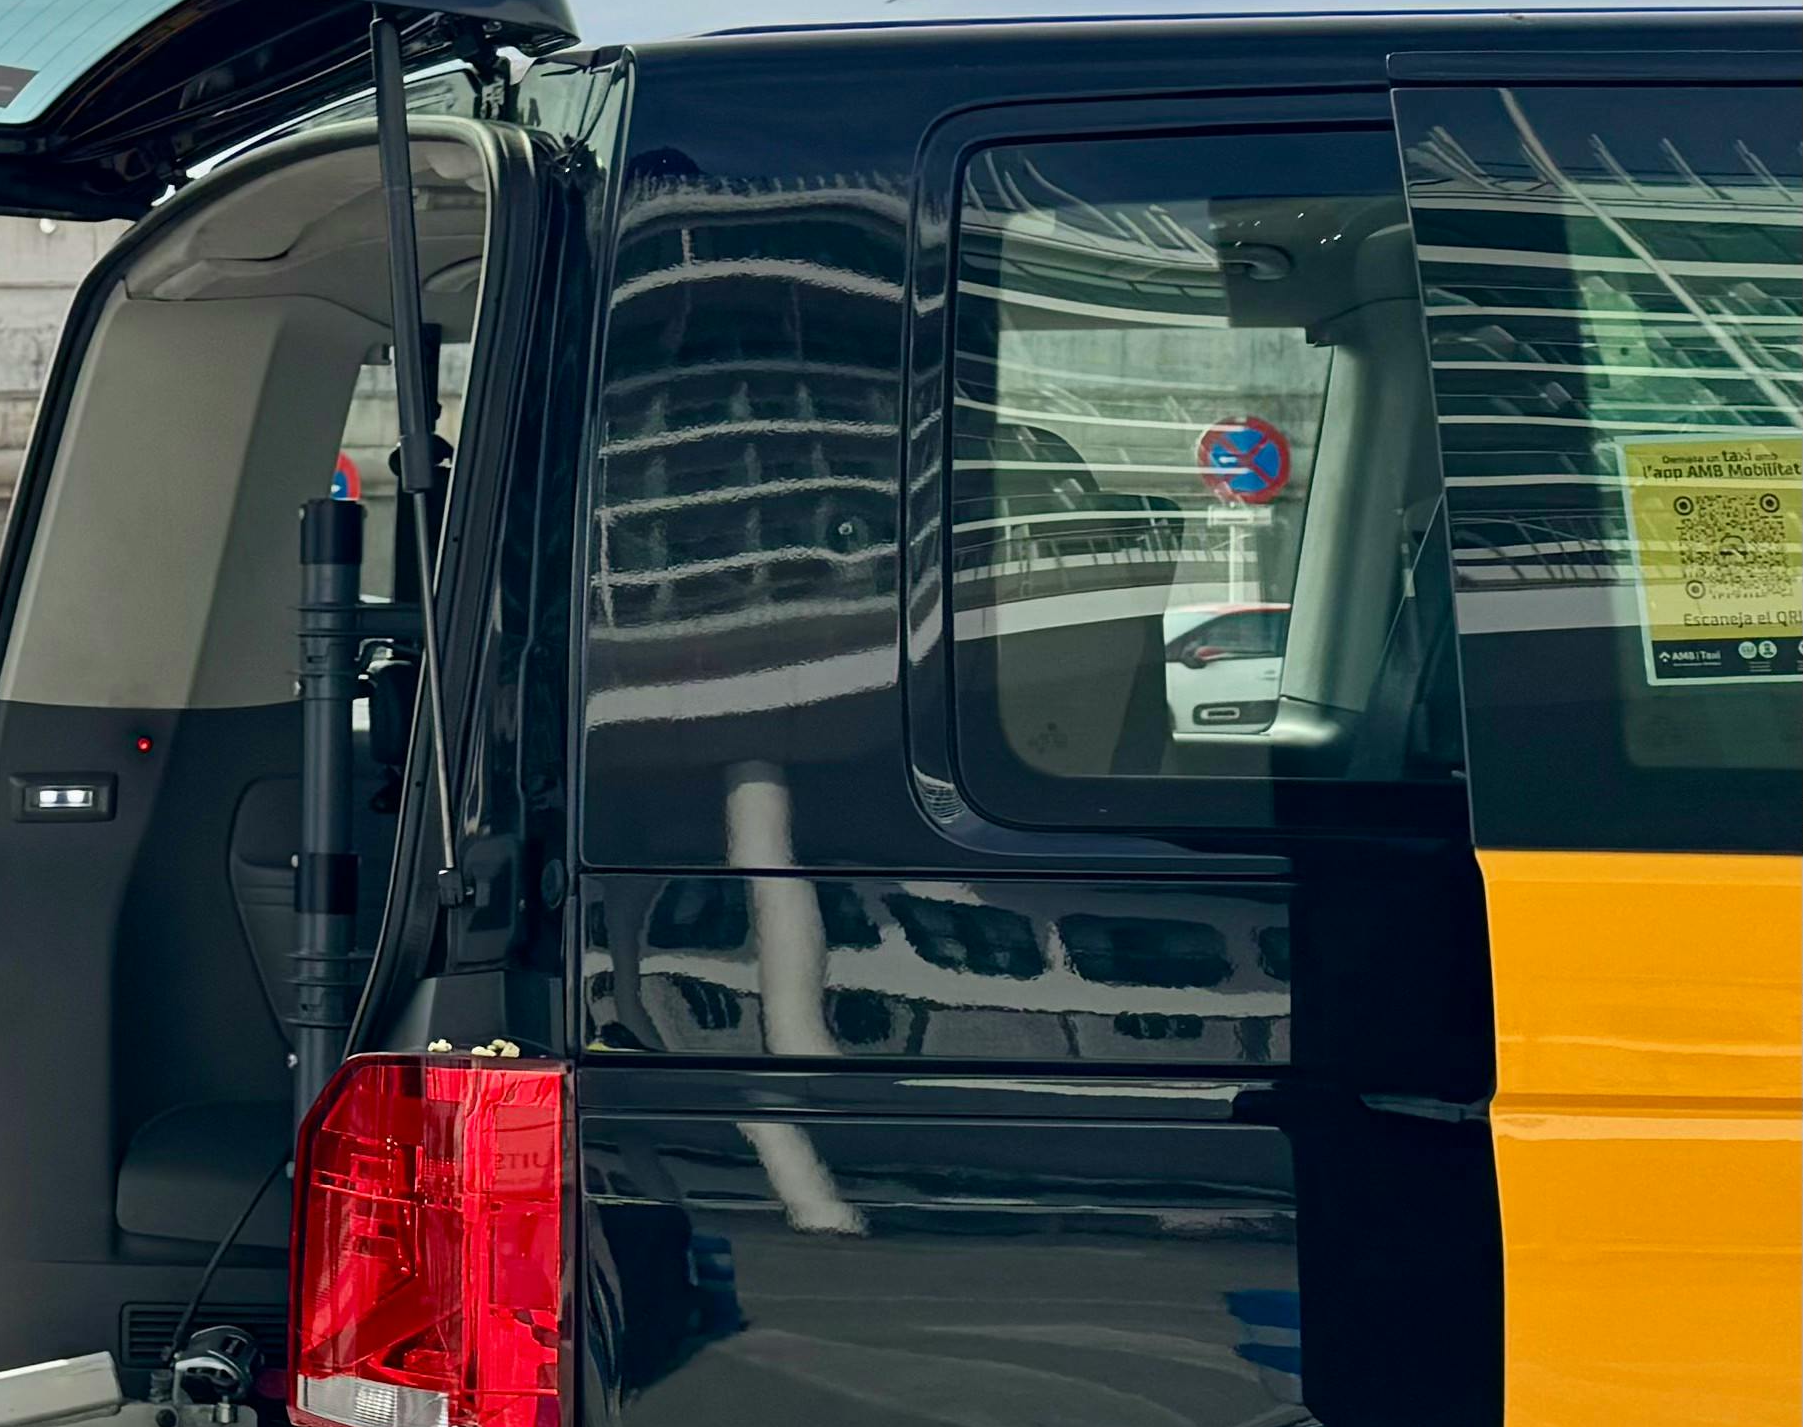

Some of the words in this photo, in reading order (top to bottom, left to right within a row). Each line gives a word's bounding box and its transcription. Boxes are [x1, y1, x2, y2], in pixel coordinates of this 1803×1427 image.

[1722, 448, 1751, 462] taxi
[1686, 464, 1724, 478] AMB
[1728, 461, 1802, 478] Mobilitat
[1683, 612, 1754, 628] Escaneja
[1757, 610, 1772, 626] el
